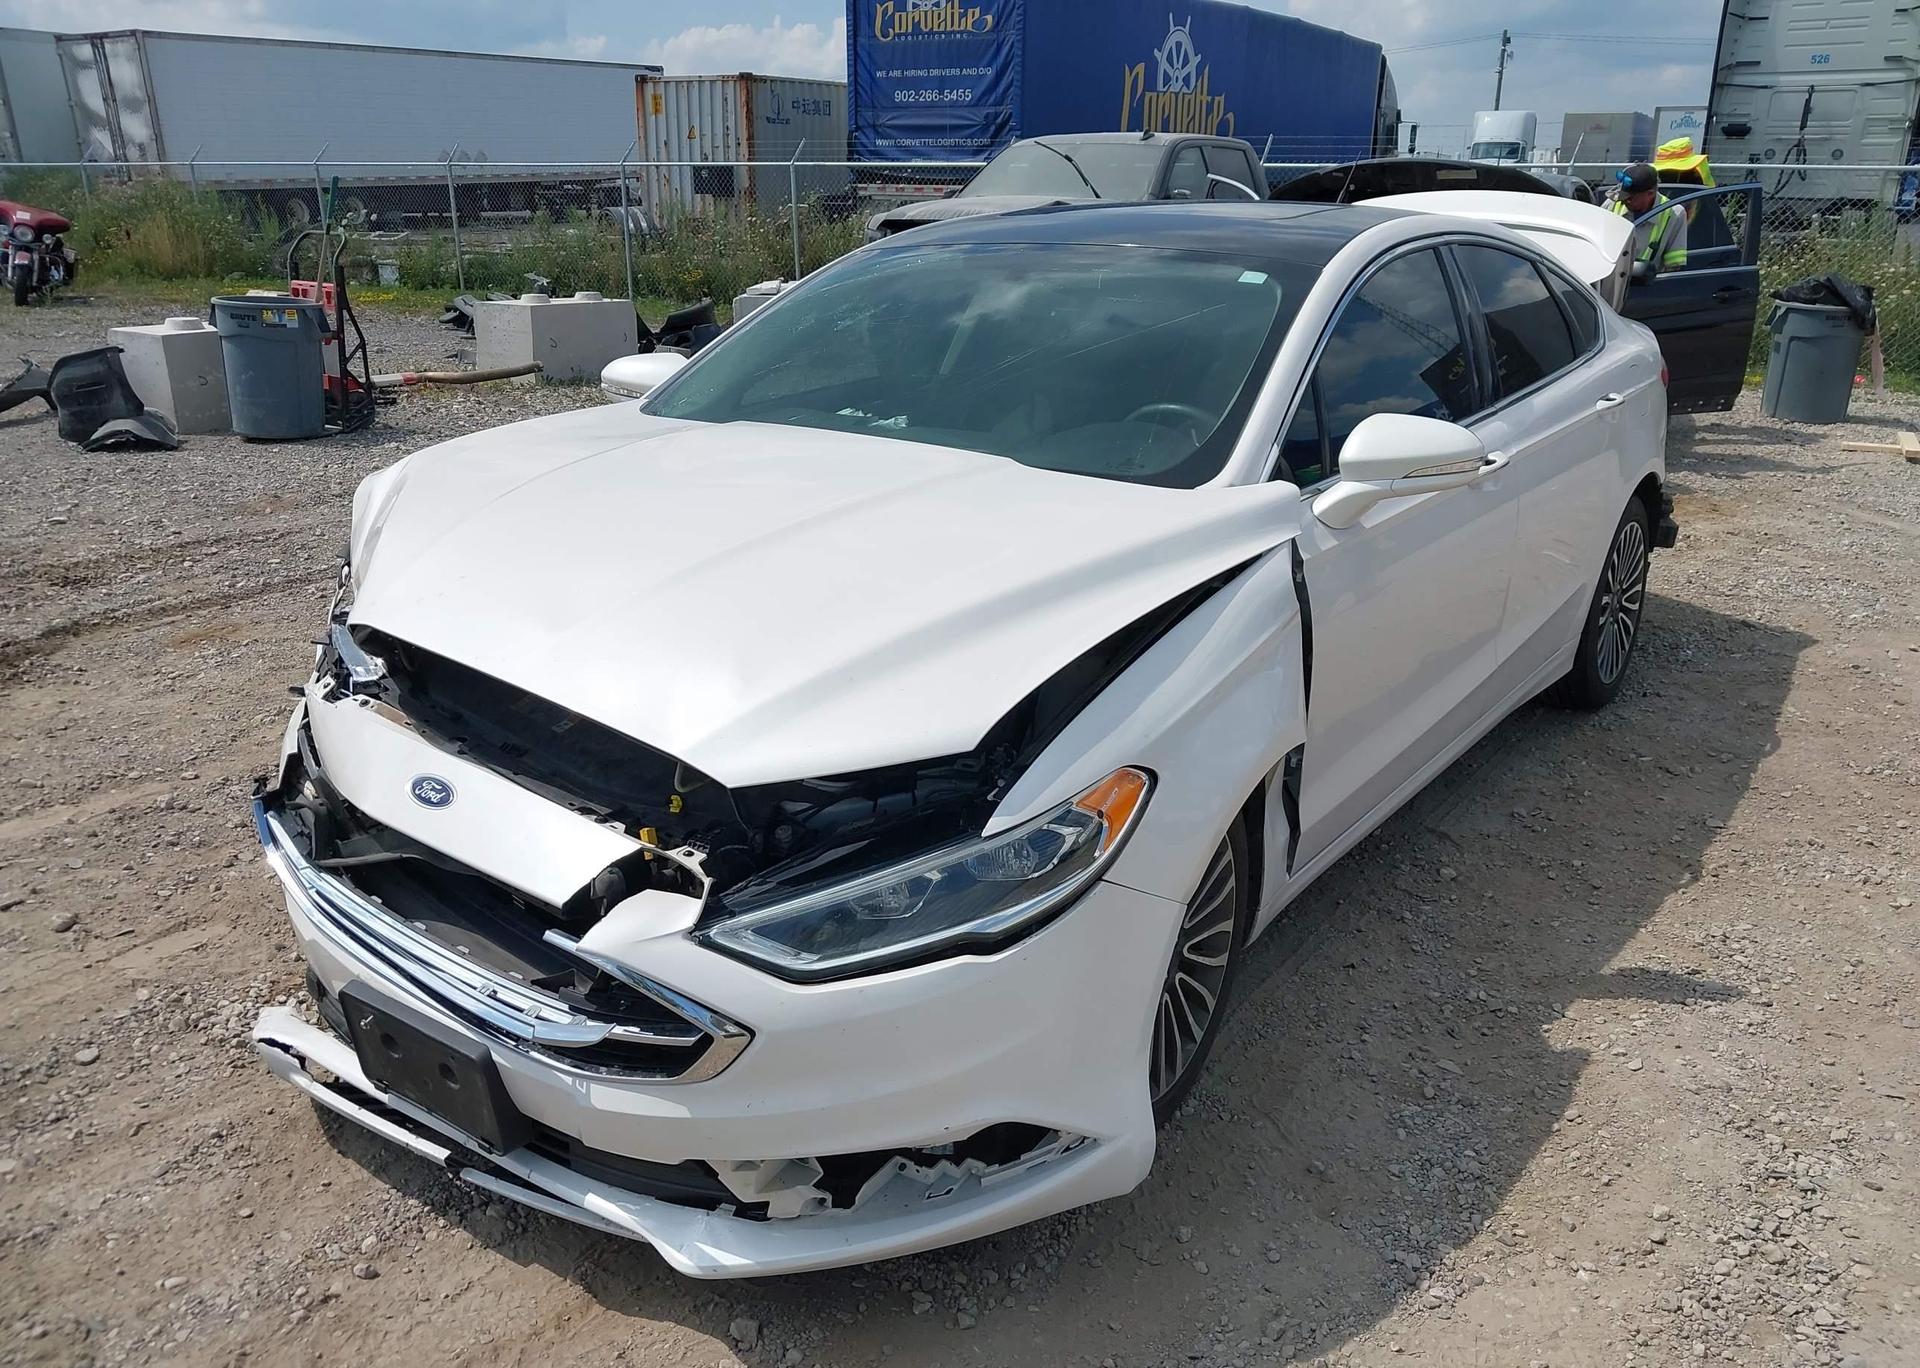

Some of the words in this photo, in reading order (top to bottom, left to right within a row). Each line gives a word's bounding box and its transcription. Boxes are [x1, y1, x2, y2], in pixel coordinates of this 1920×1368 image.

[874, 0, 993, 42] Corvette
[894, 34, 946, 42] LOGISTICS
[1810, 53, 1831, 65] 526
[876, 69, 887, 78] WE
[888, 69, 903, 77] ARE
[904, 68, 928, 77] HIRING
[929, 67, 961, 76] DRIVERS
[961, 67, 978, 75] AND
[894, 88, 972, 102] 902-266-5455
[875, 137, 991, 147] WWW.CORVETTELOGISTICS.COM
[415, 780, 446, 803] Ford
